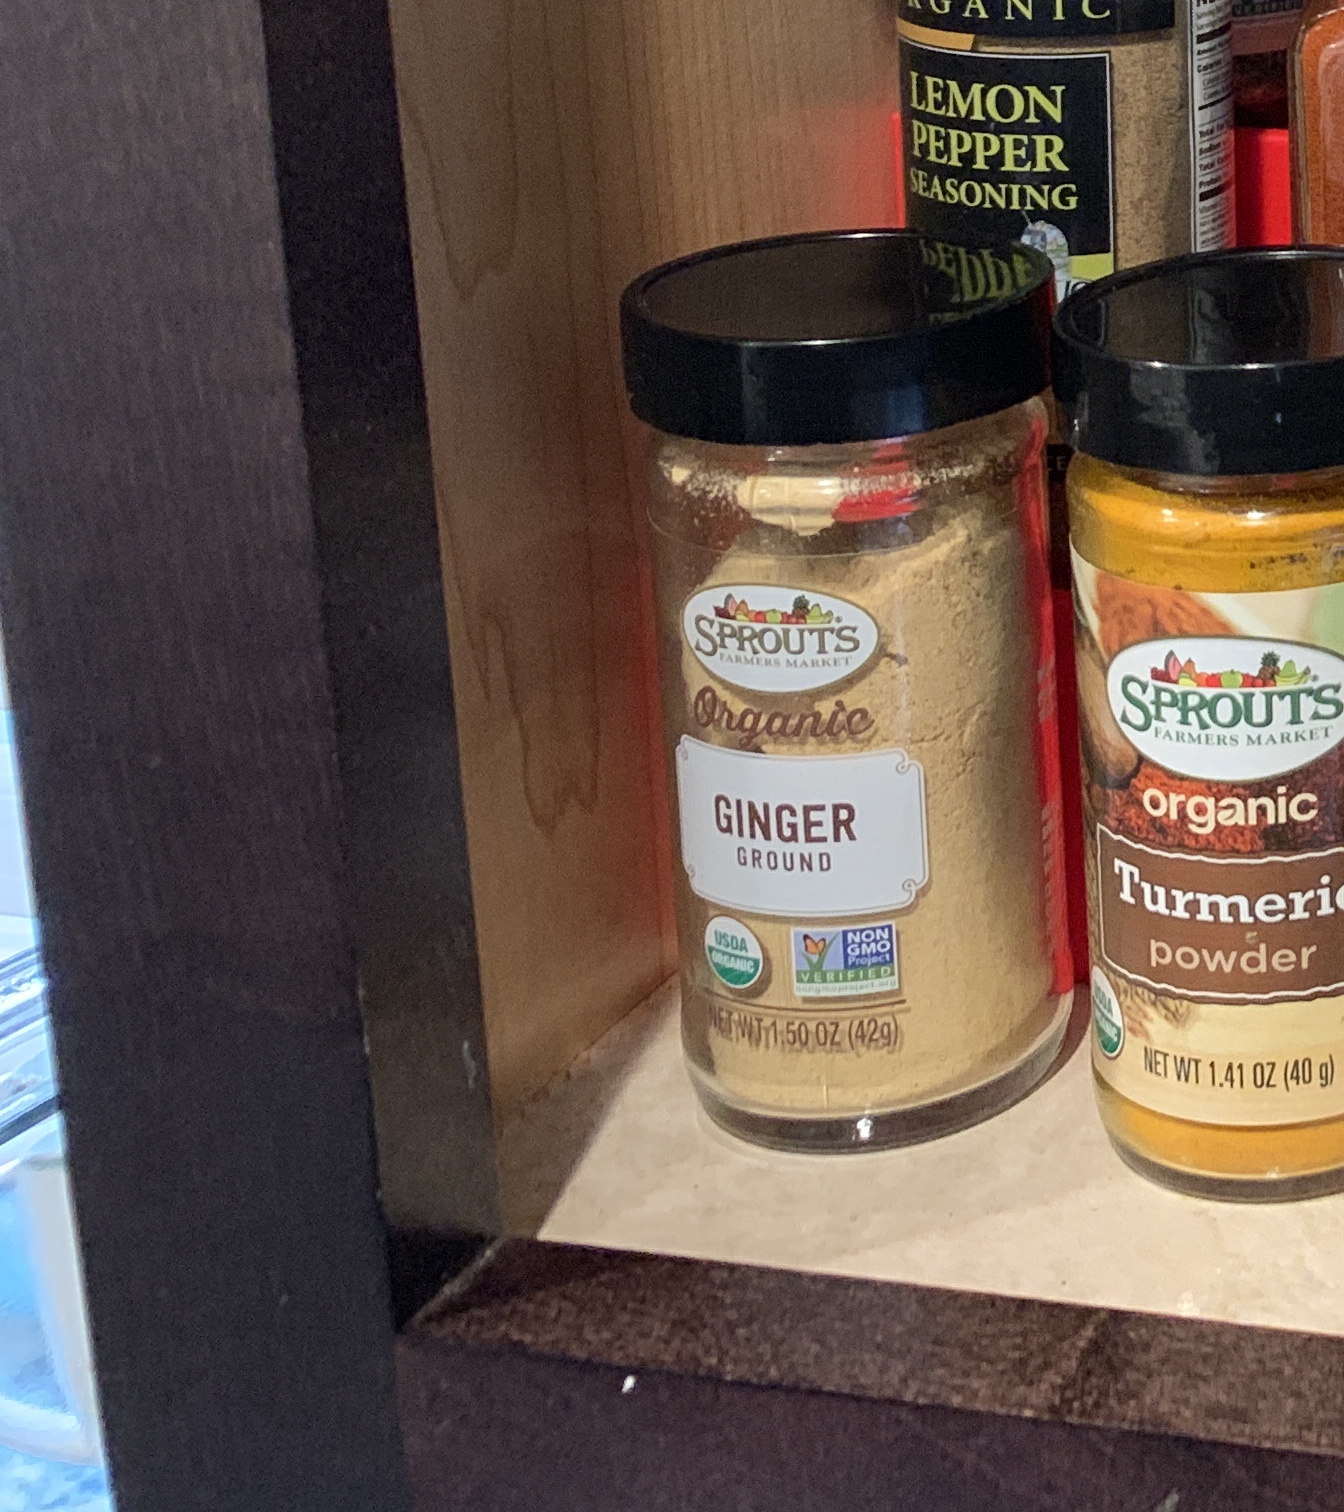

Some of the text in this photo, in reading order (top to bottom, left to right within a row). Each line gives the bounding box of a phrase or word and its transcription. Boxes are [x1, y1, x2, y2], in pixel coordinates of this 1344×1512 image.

[910, 71, 1066, 124] LEMON
[911, 119, 1069, 172] PEPPER
[910, 167, 1078, 211] SEASONING
[694, 614, 861, 657] SPROUTS
[720, 652, 852, 668] FARMERS MARKET
[694, 685, 875, 747] Organic
[1119, 675, 1344, 731] SPROUTS
[1154, 725, 1334, 747] FARMERS MARKET
[714, 794, 857, 843] GINGER
[1143, 787, 1319, 834] organic
[737, 846, 832, 874] GROUND
[714, 929, 748, 953] USDA
[846, 940, 891, 957] GMO
[847, 927, 889, 943] NON
[848, 953, 890, 967] Project
[1150, 938, 1318, 973] powder
[800, 966, 891, 983] VERIFIED
[771, 1019, 809, 1046] 1.50
[816, 1021, 840, 1046] OZ
[848, 1014, 899, 1050] (42g)
[1144, 1045, 1335, 1092] NET WT 1.41 OZ (40 g)
